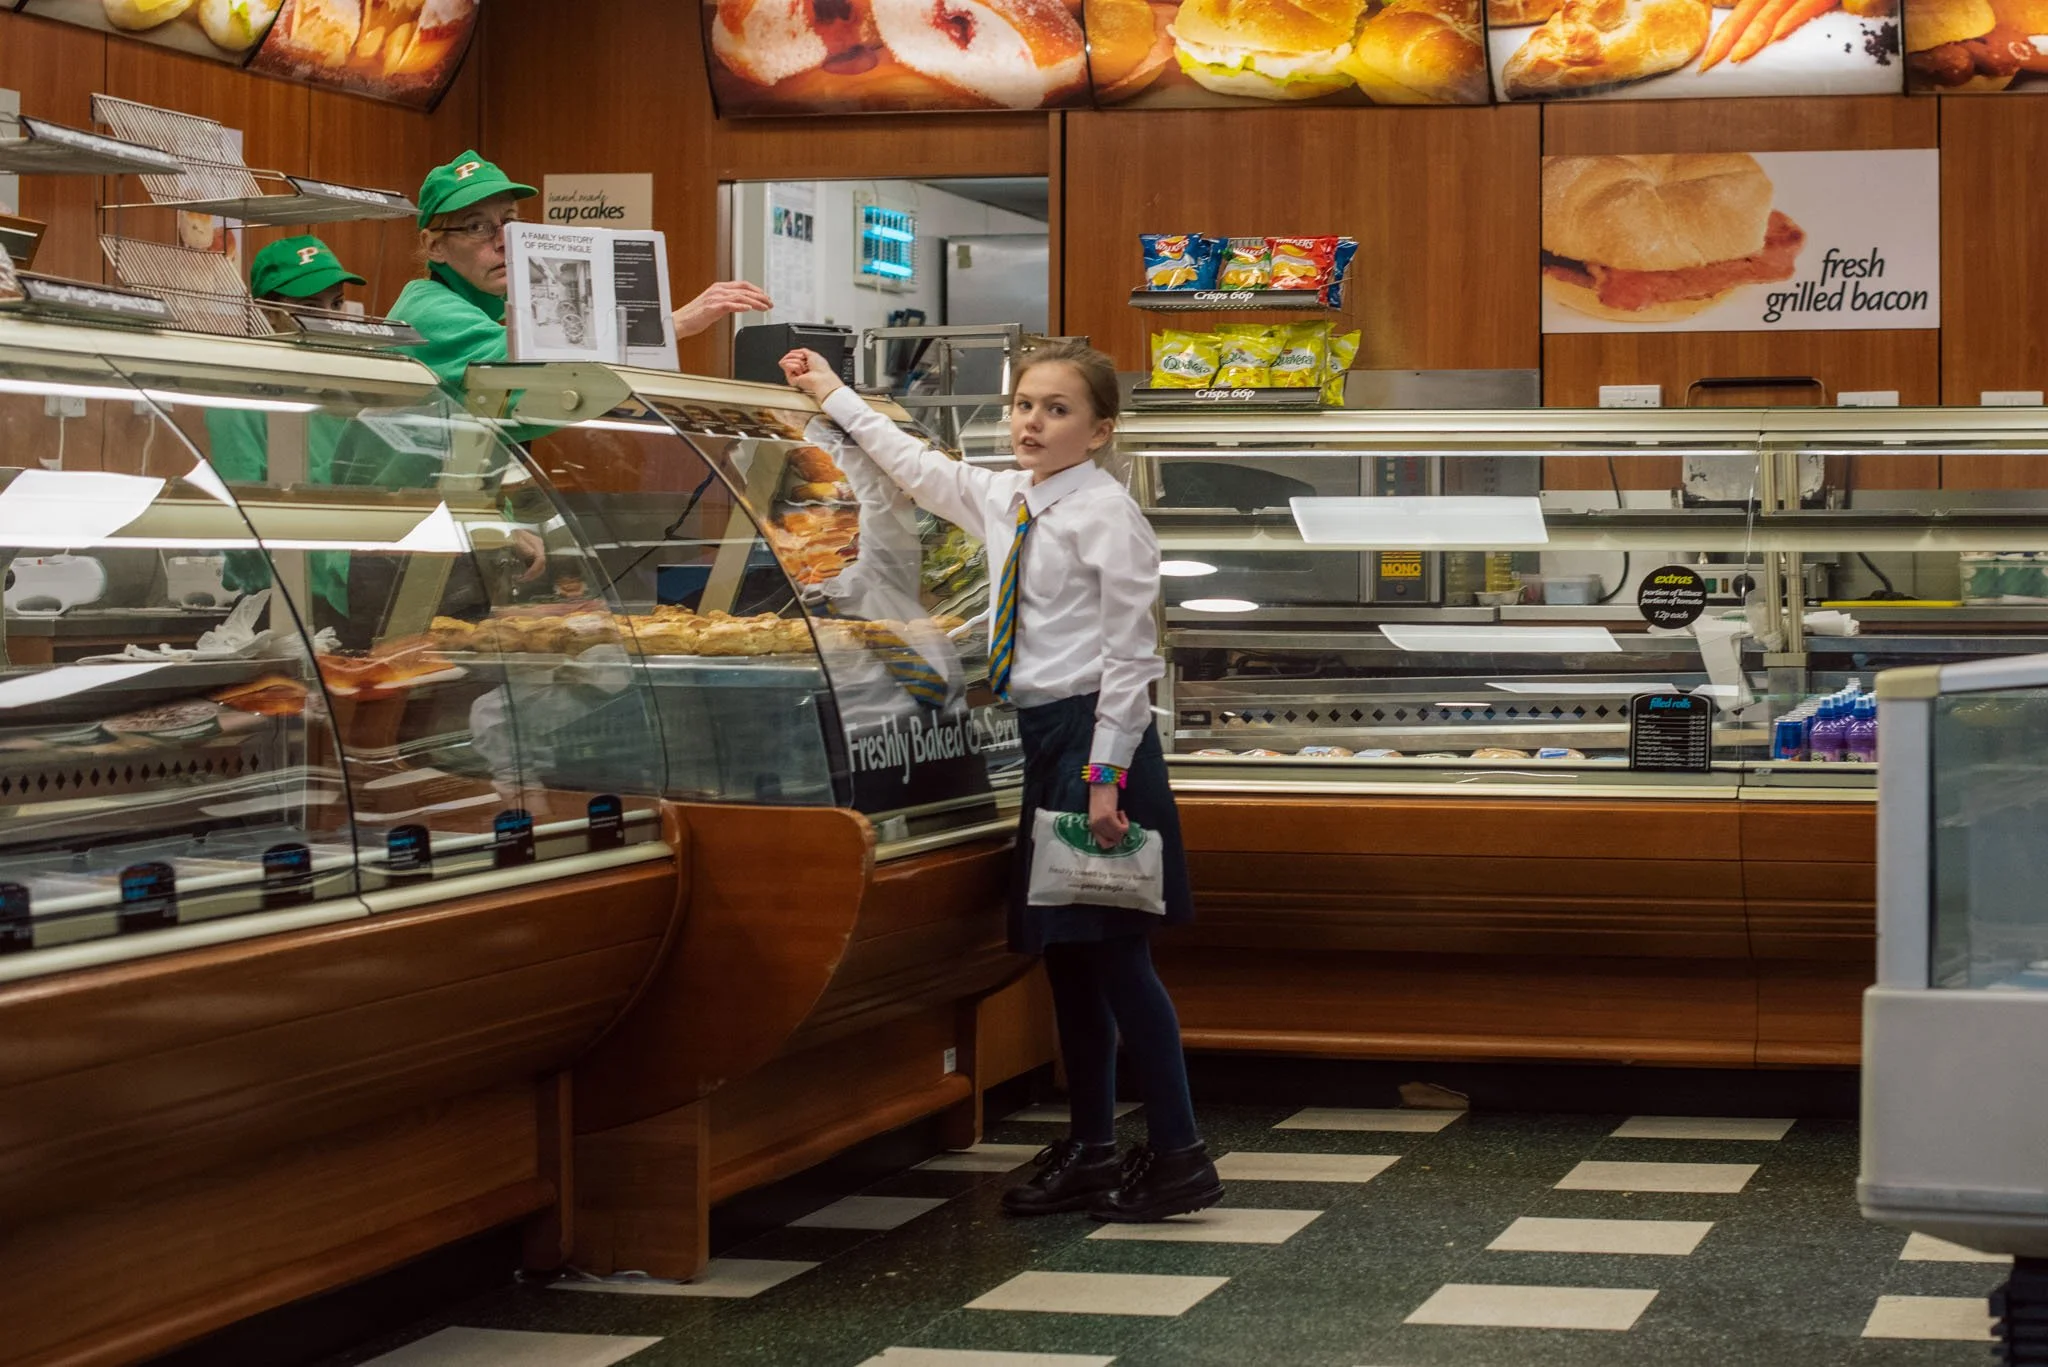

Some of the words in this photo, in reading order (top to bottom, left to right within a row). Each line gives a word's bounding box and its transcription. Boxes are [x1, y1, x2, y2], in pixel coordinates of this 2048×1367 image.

[456, 161, 481, 181] P
[548, 206, 578, 224] cup
[580, 201, 625, 219] cakes
[528, 232, 557, 241] FAMILY
[558, 234, 594, 244] HISTORY
[524, 241, 536, 249] OF
[537, 242, 566, 251] PERCY
[567, 244, 593, 254] INGLE
[296, 246, 320, 266] P
[1820, 247, 1886, 287] fresh
[1194, 291, 1228, 302] Crisps
[1230, 291, 1254, 302] 66p
[1762, 281, 1846, 323] grilled
[1850, 281, 1928, 311] bacon
[1195, 388, 1230, 401] Crisps
[1231, 388, 1256, 400] 66p
[1381, 563, 1421, 576] MONO
[1654, 573, 1694, 585] extras
[1642, 588, 1670, 598] portion
[1670, 588, 1680, 598] of
[1640, 597, 1668, 606] portion
[1668, 597, 1678, 606] of
[1676, 597, 1704, 605] tomato
[1654, 610, 1670, 621] 12p
[1670, 610, 1688, 619] each
[1649, 698, 1672, 710] filled
[1672, 698, 1692, 709] rolls
[845, 713, 910, 784] Freshly
[909, 707, 966, 763] Baked
[966, 709, 981, 754] &
